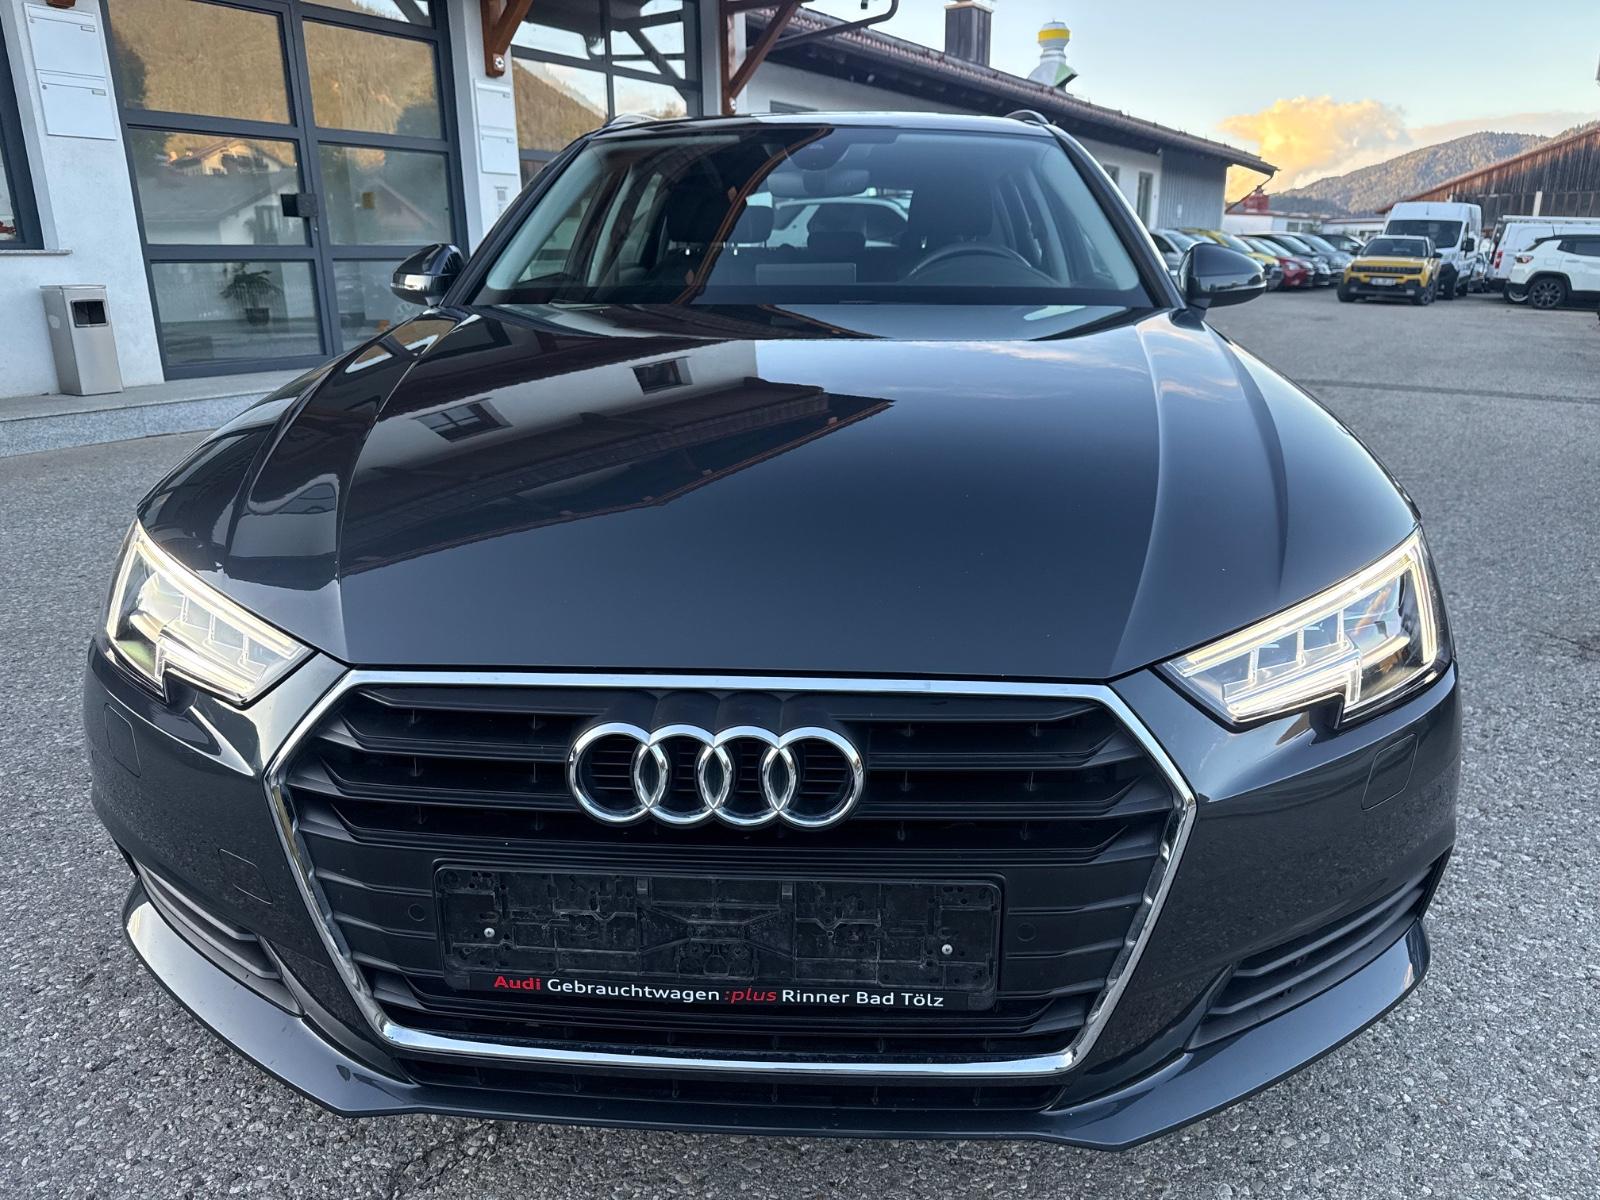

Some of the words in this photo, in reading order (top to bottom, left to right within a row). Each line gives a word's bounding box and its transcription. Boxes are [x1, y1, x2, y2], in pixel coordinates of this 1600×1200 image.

[494, 976, 541, 990] Audi
[547, 978, 720, 1003] Gebrauchtwagen
[782, 989, 850, 1004] Rinner
[856, 991, 895, 1005] Bad
[901, 992, 944, 1007] Tölz
